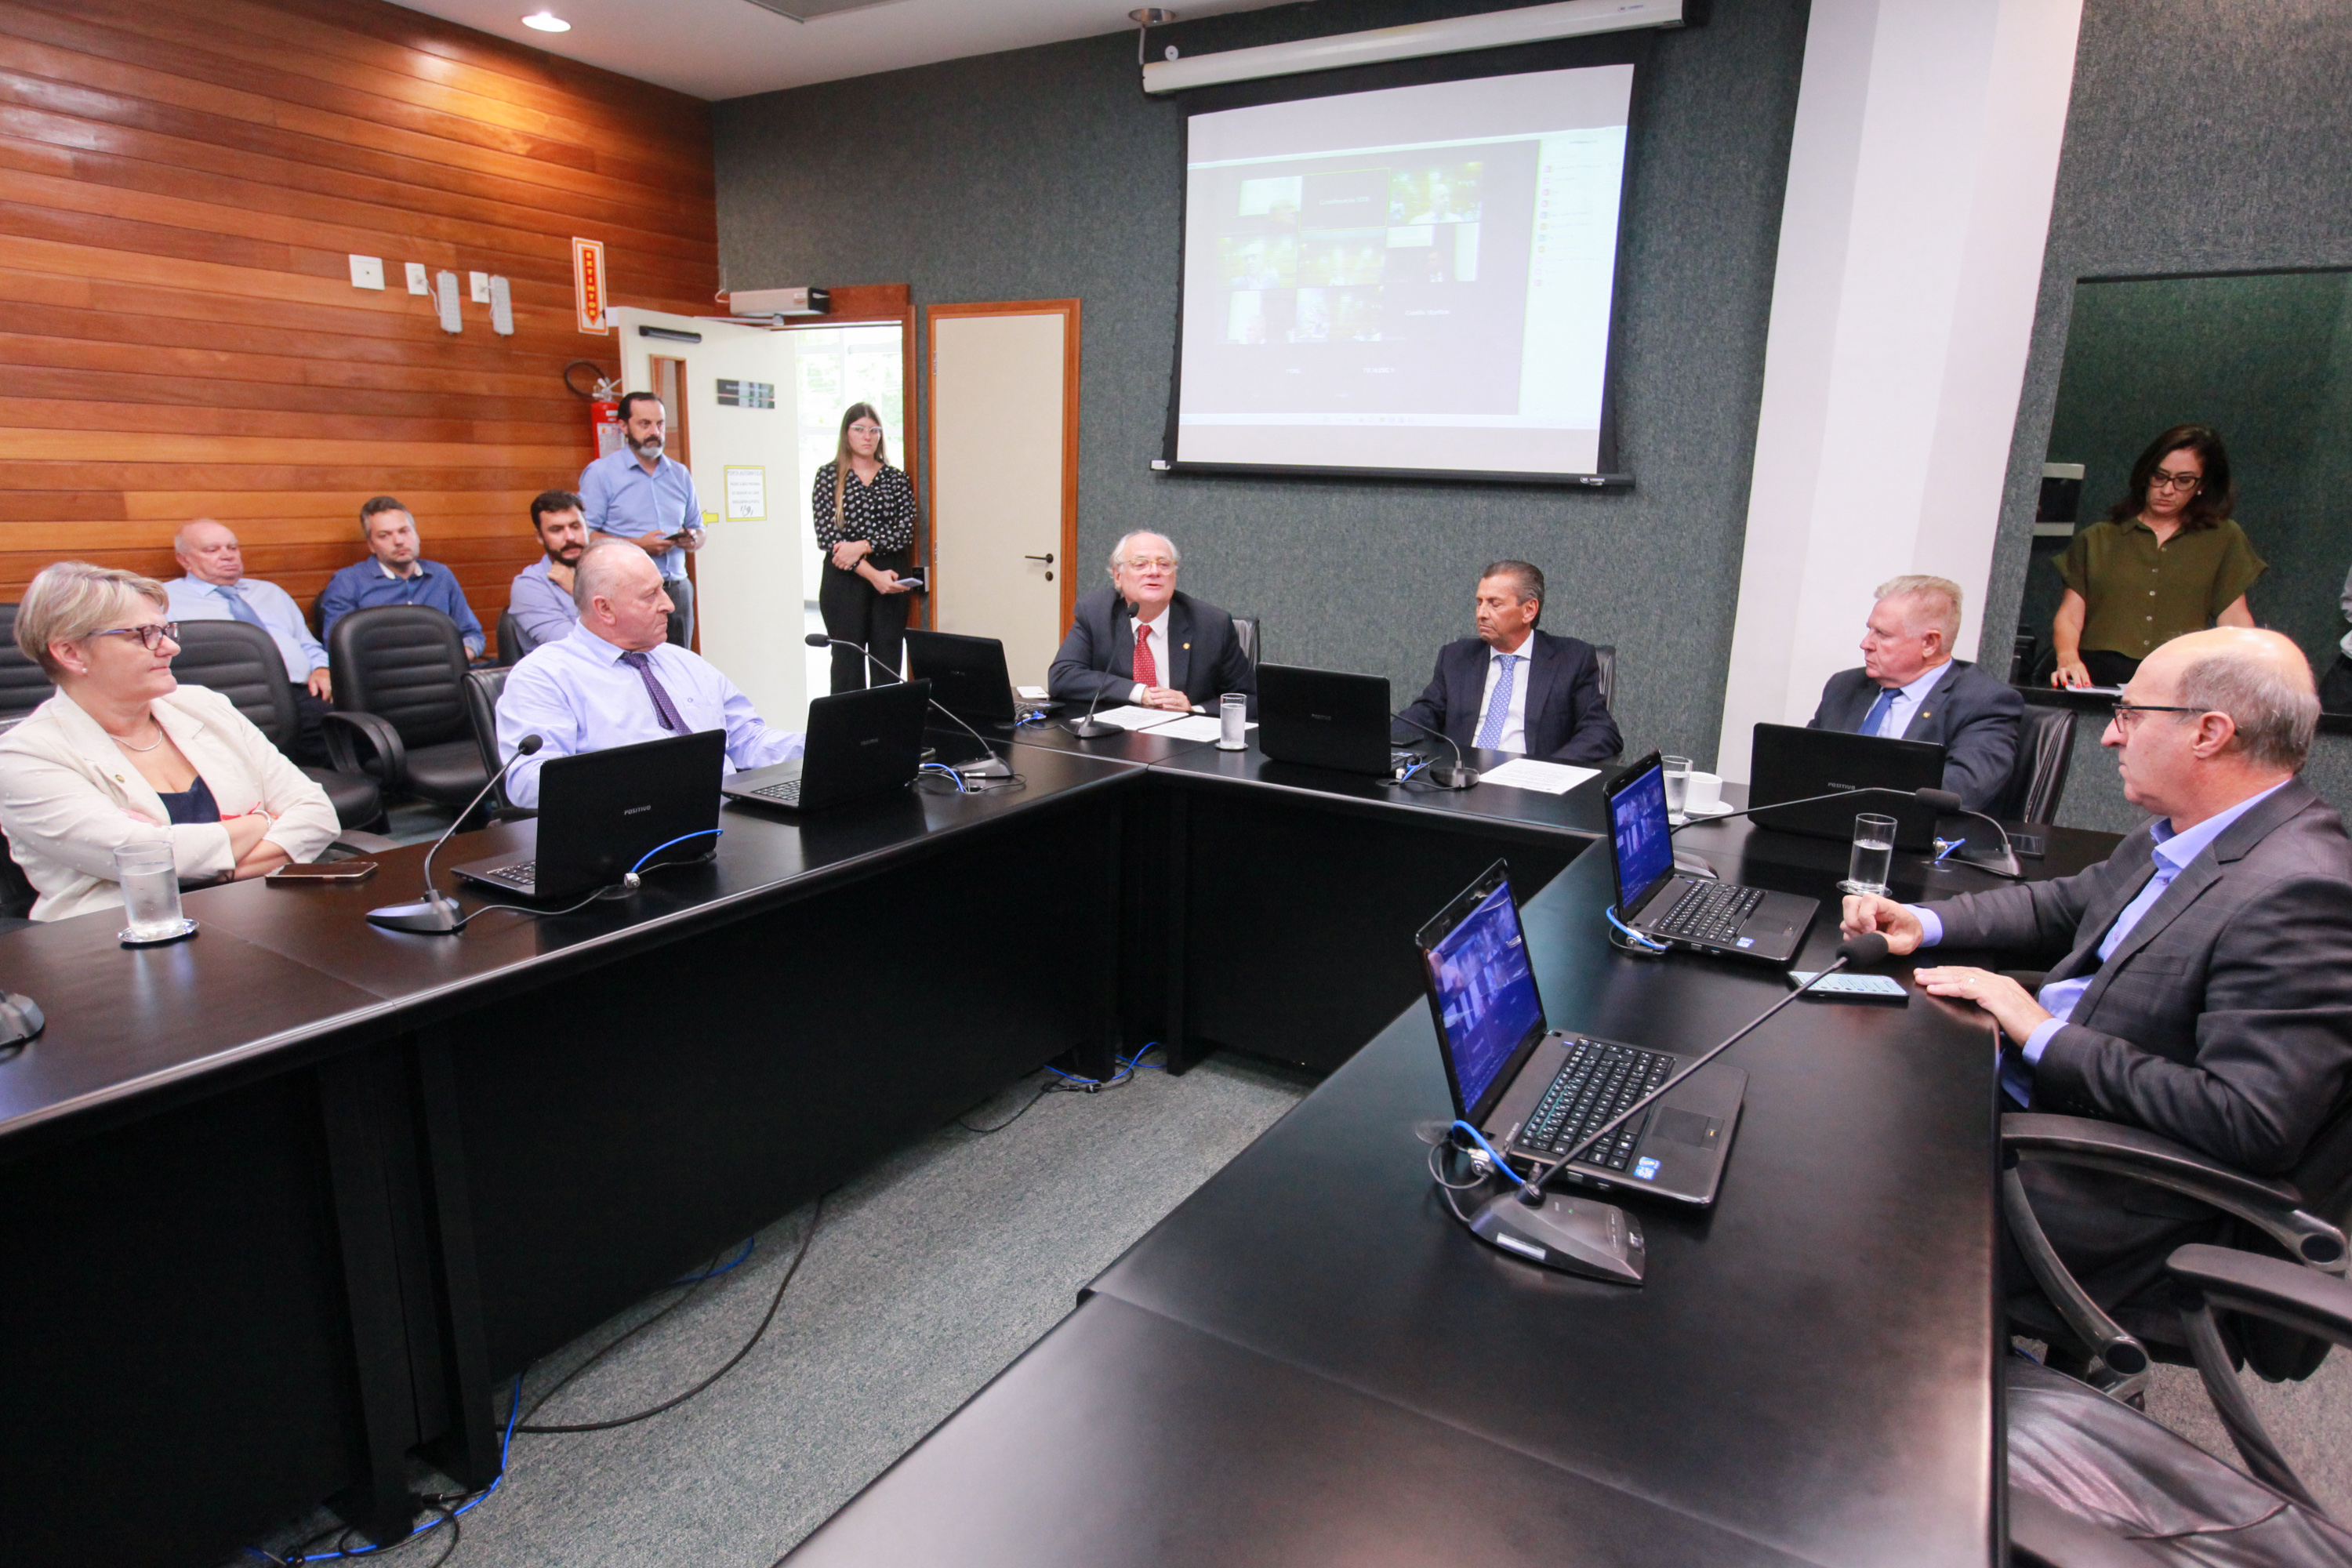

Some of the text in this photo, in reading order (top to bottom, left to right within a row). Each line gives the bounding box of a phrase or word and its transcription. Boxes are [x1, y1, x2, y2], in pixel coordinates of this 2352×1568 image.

[586, 252, 597, 316] EXTINTOR
[1828, 782, 1856, 790] POSITIVO
[624, 804, 652, 816] POSITIVO
